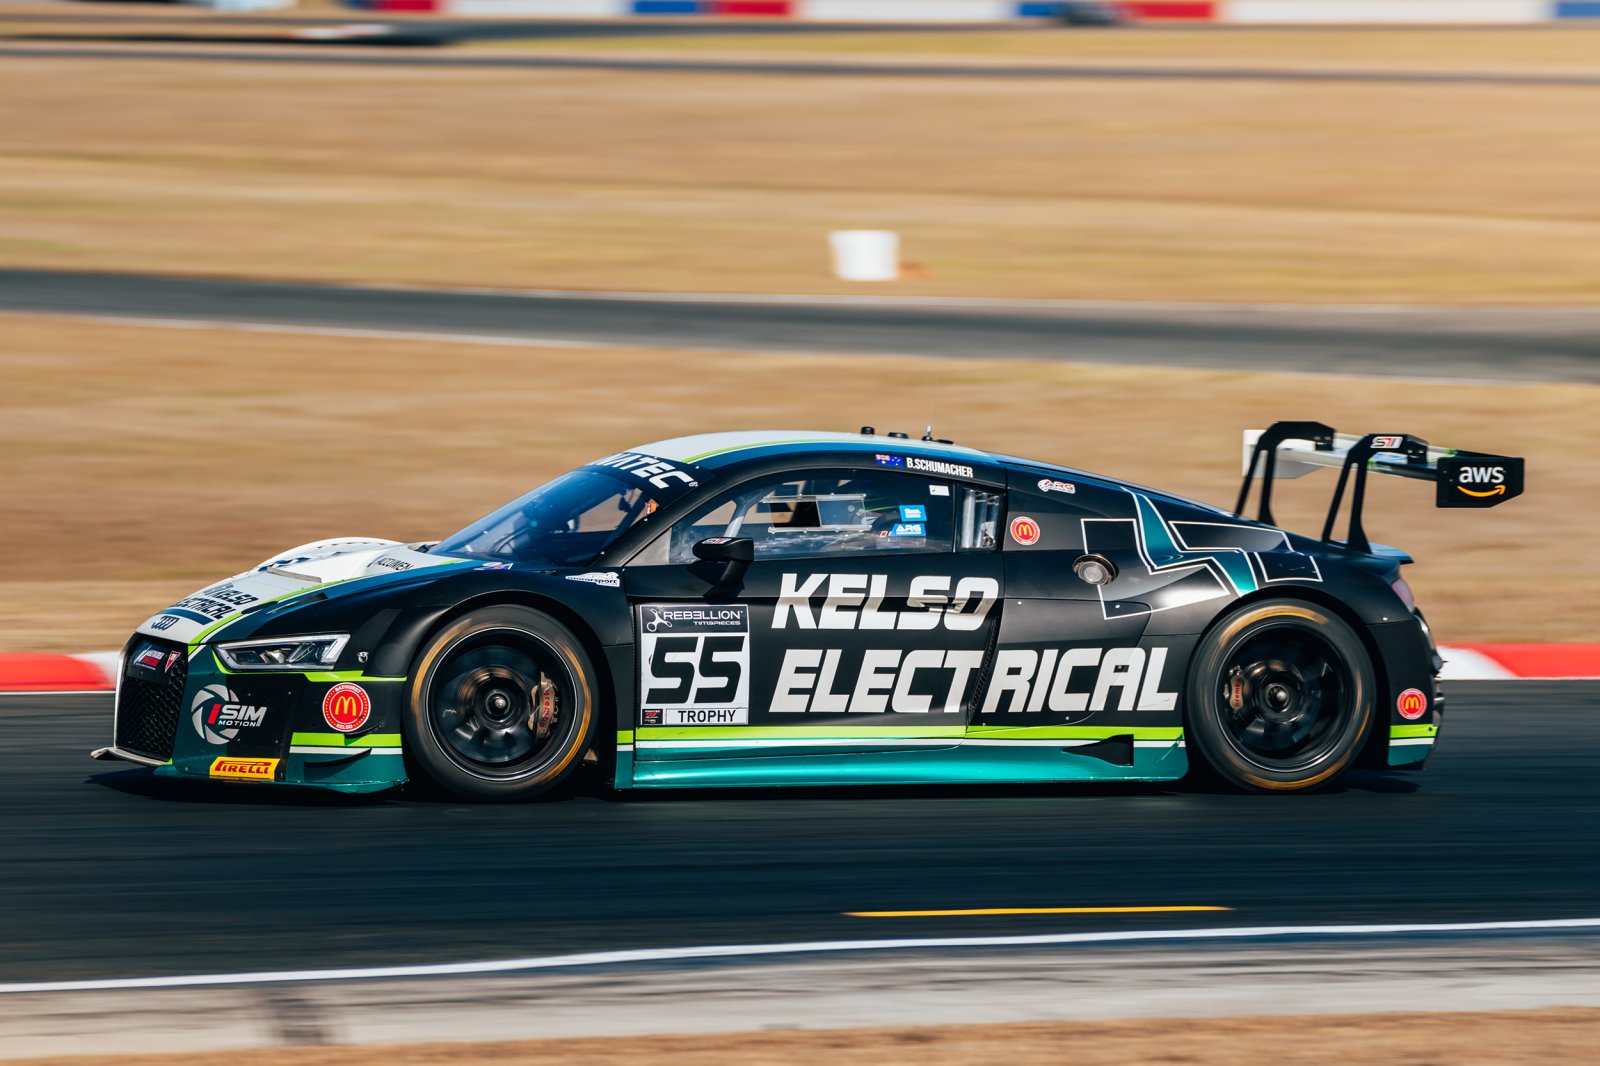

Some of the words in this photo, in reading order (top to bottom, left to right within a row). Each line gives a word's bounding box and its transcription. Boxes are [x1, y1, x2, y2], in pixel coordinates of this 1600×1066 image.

[906, 457, 974, 479] B.SCHUMACHER
[1458, 466, 1505, 483] aws
[771, 573, 999, 631] KELSO
[646, 635, 746, 704] 55
[768, 647, 1179, 713] ELECTRICAL
[678, 709, 737, 723] TROPHY
[214, 760, 272, 774] PIRELLI
